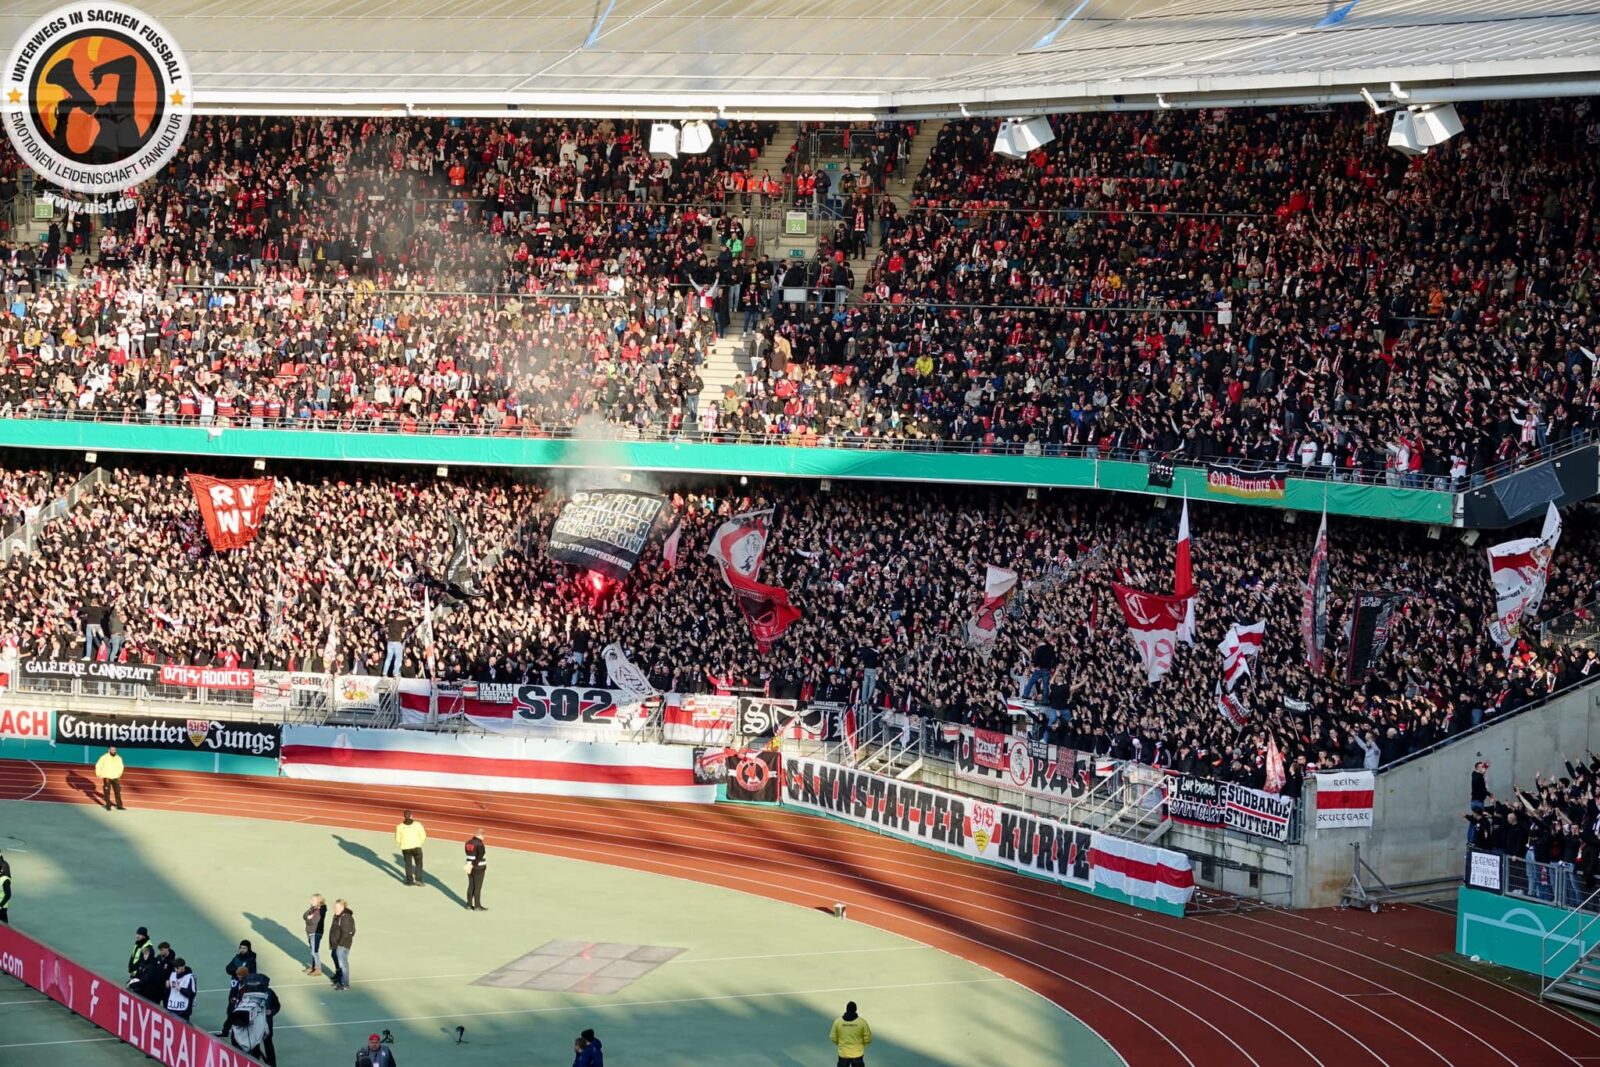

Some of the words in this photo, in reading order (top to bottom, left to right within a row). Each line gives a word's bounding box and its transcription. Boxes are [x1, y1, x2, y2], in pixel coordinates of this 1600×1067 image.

[1210, 470, 1227, 486] Old
[1230, 472, 1270, 493] Warriors
[88, 663, 154, 681] CANNSTATT
[201, 670, 250, 686] ADDICTS
[479, 683, 513, 693] ULTRAS
[0, 710, 48, 736] ACH
[58, 714, 187, 744] Cannstatter
[205, 720, 275, 754] Jungs
[786, 759, 966, 847] CANNSTATTER
[998, 812, 1091, 881] KURVE
[1170, 799, 1221, 823] STUTTGART
